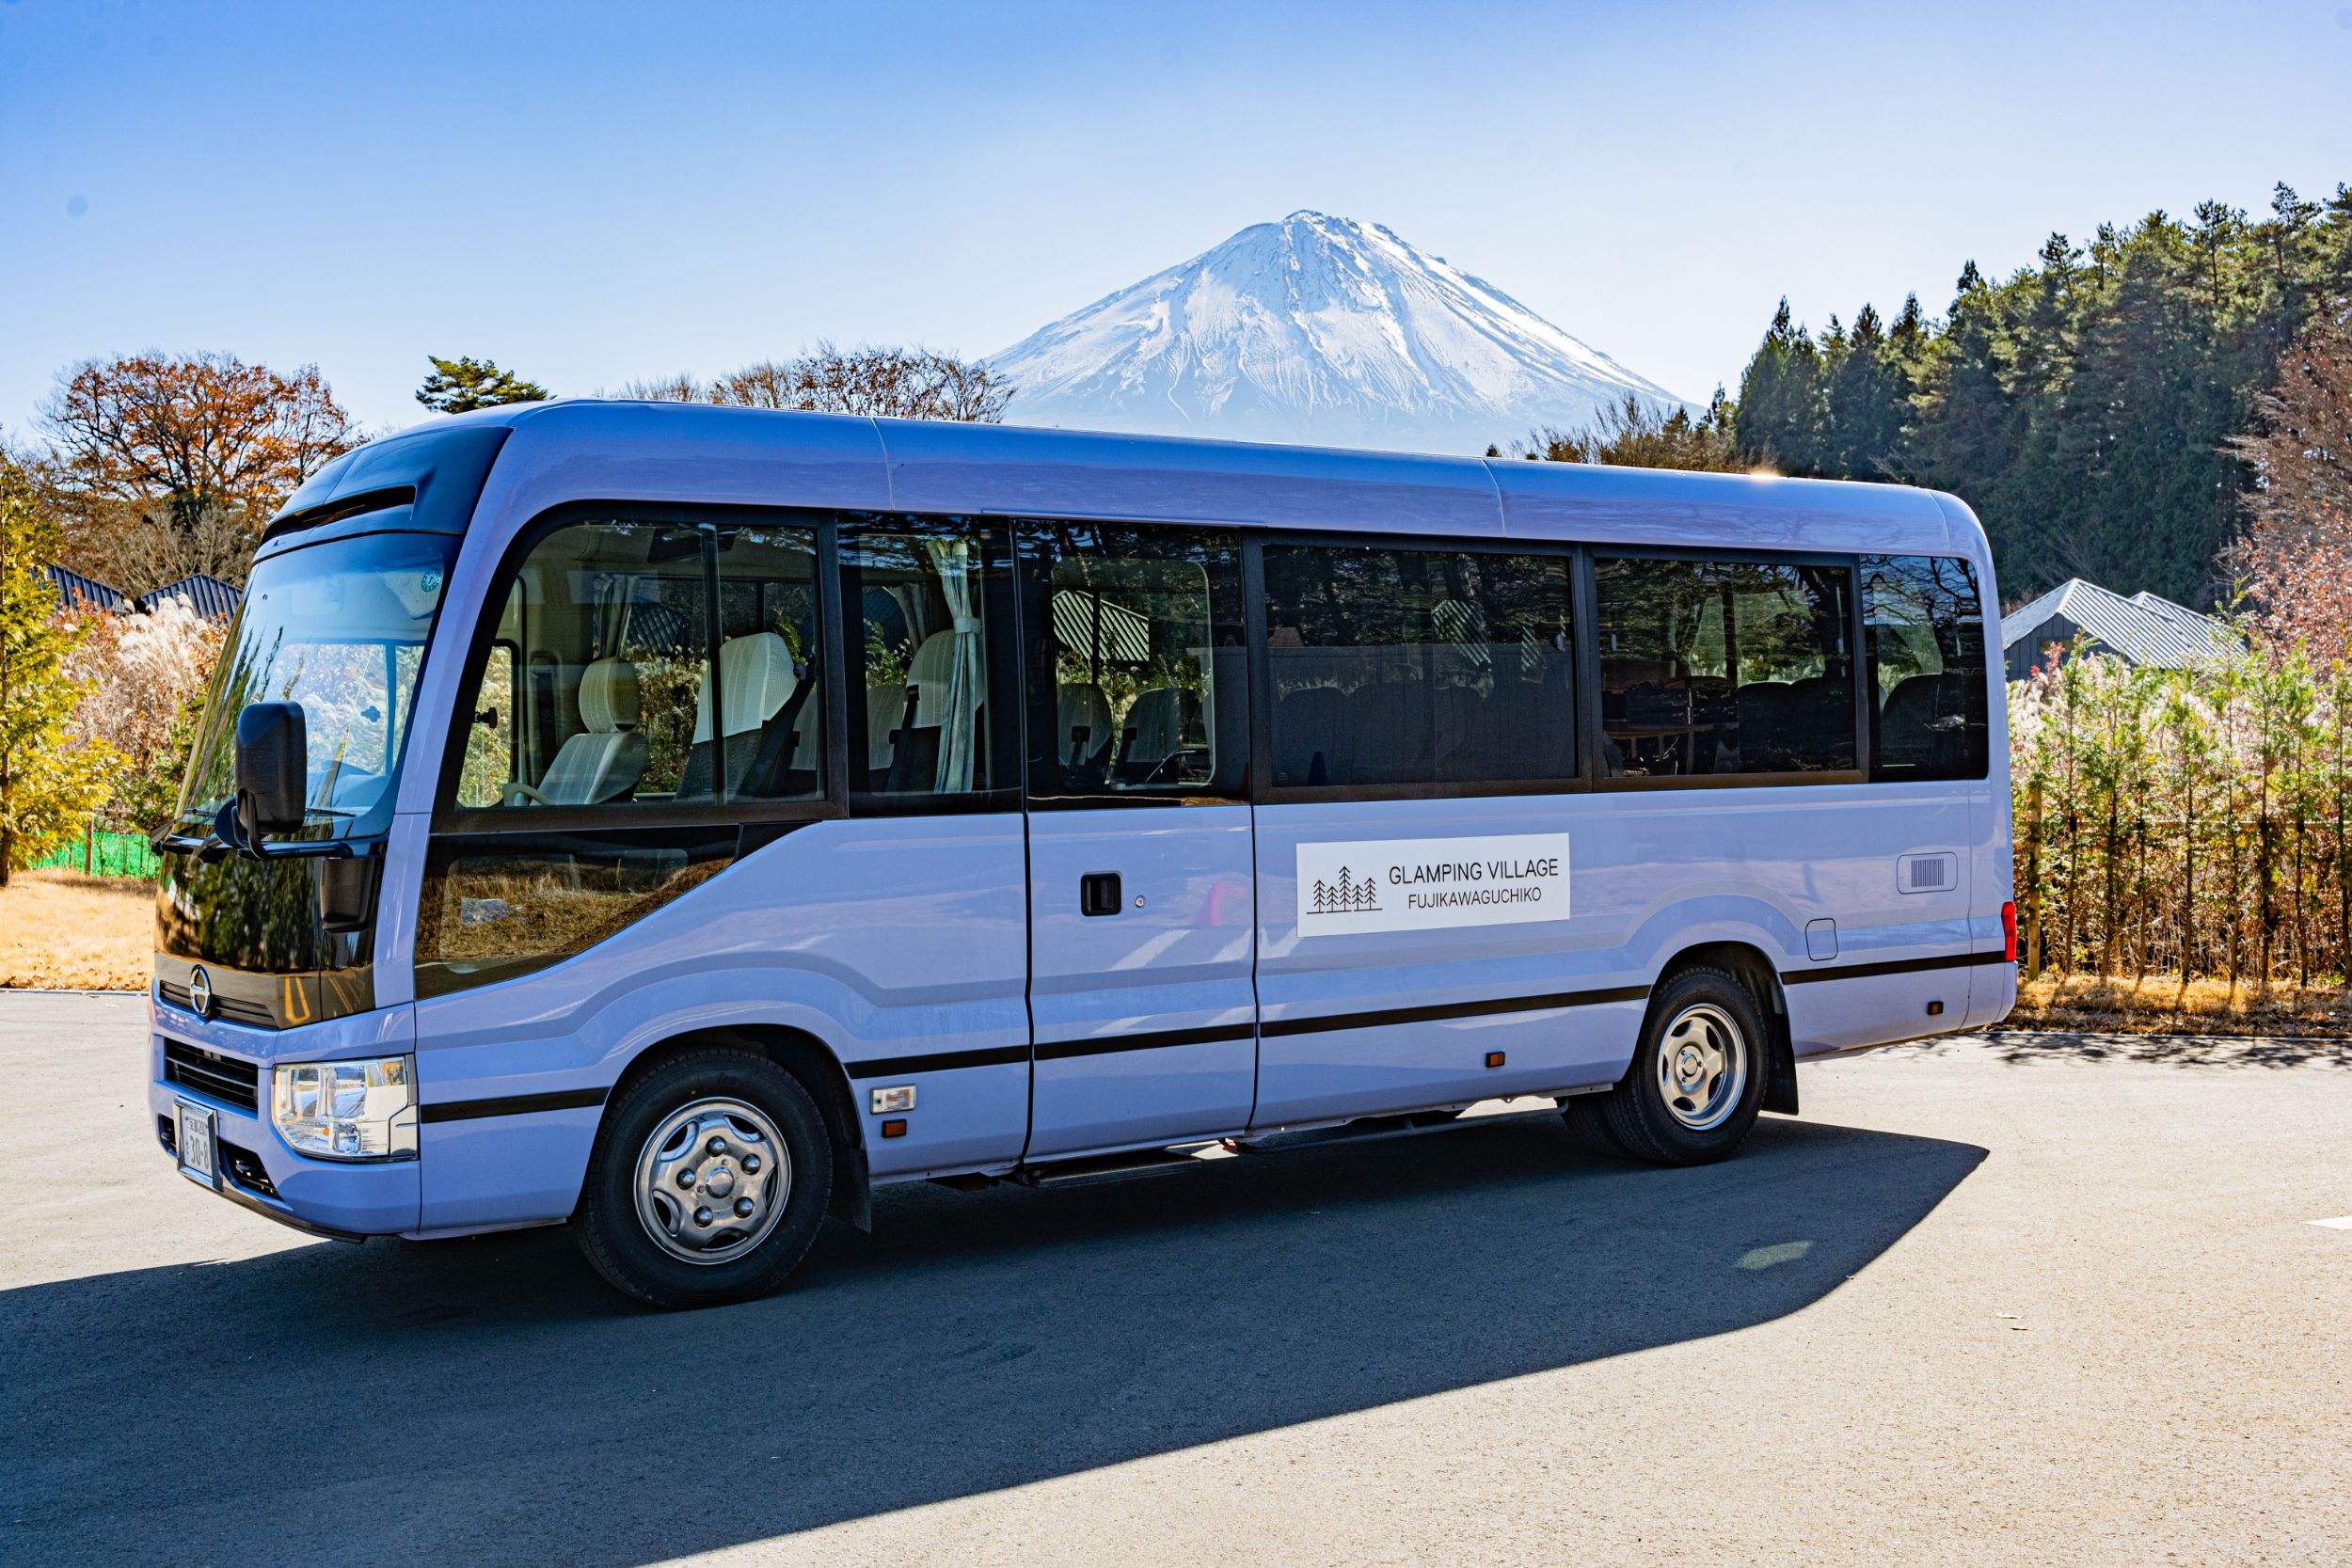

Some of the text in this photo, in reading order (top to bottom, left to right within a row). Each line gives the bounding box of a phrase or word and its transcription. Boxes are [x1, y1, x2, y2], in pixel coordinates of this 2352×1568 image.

[1389, 859, 1559, 884] GLAMPING VILLAGE
[1408, 887, 1542, 909] FUJIKAWAGUCHIKO
